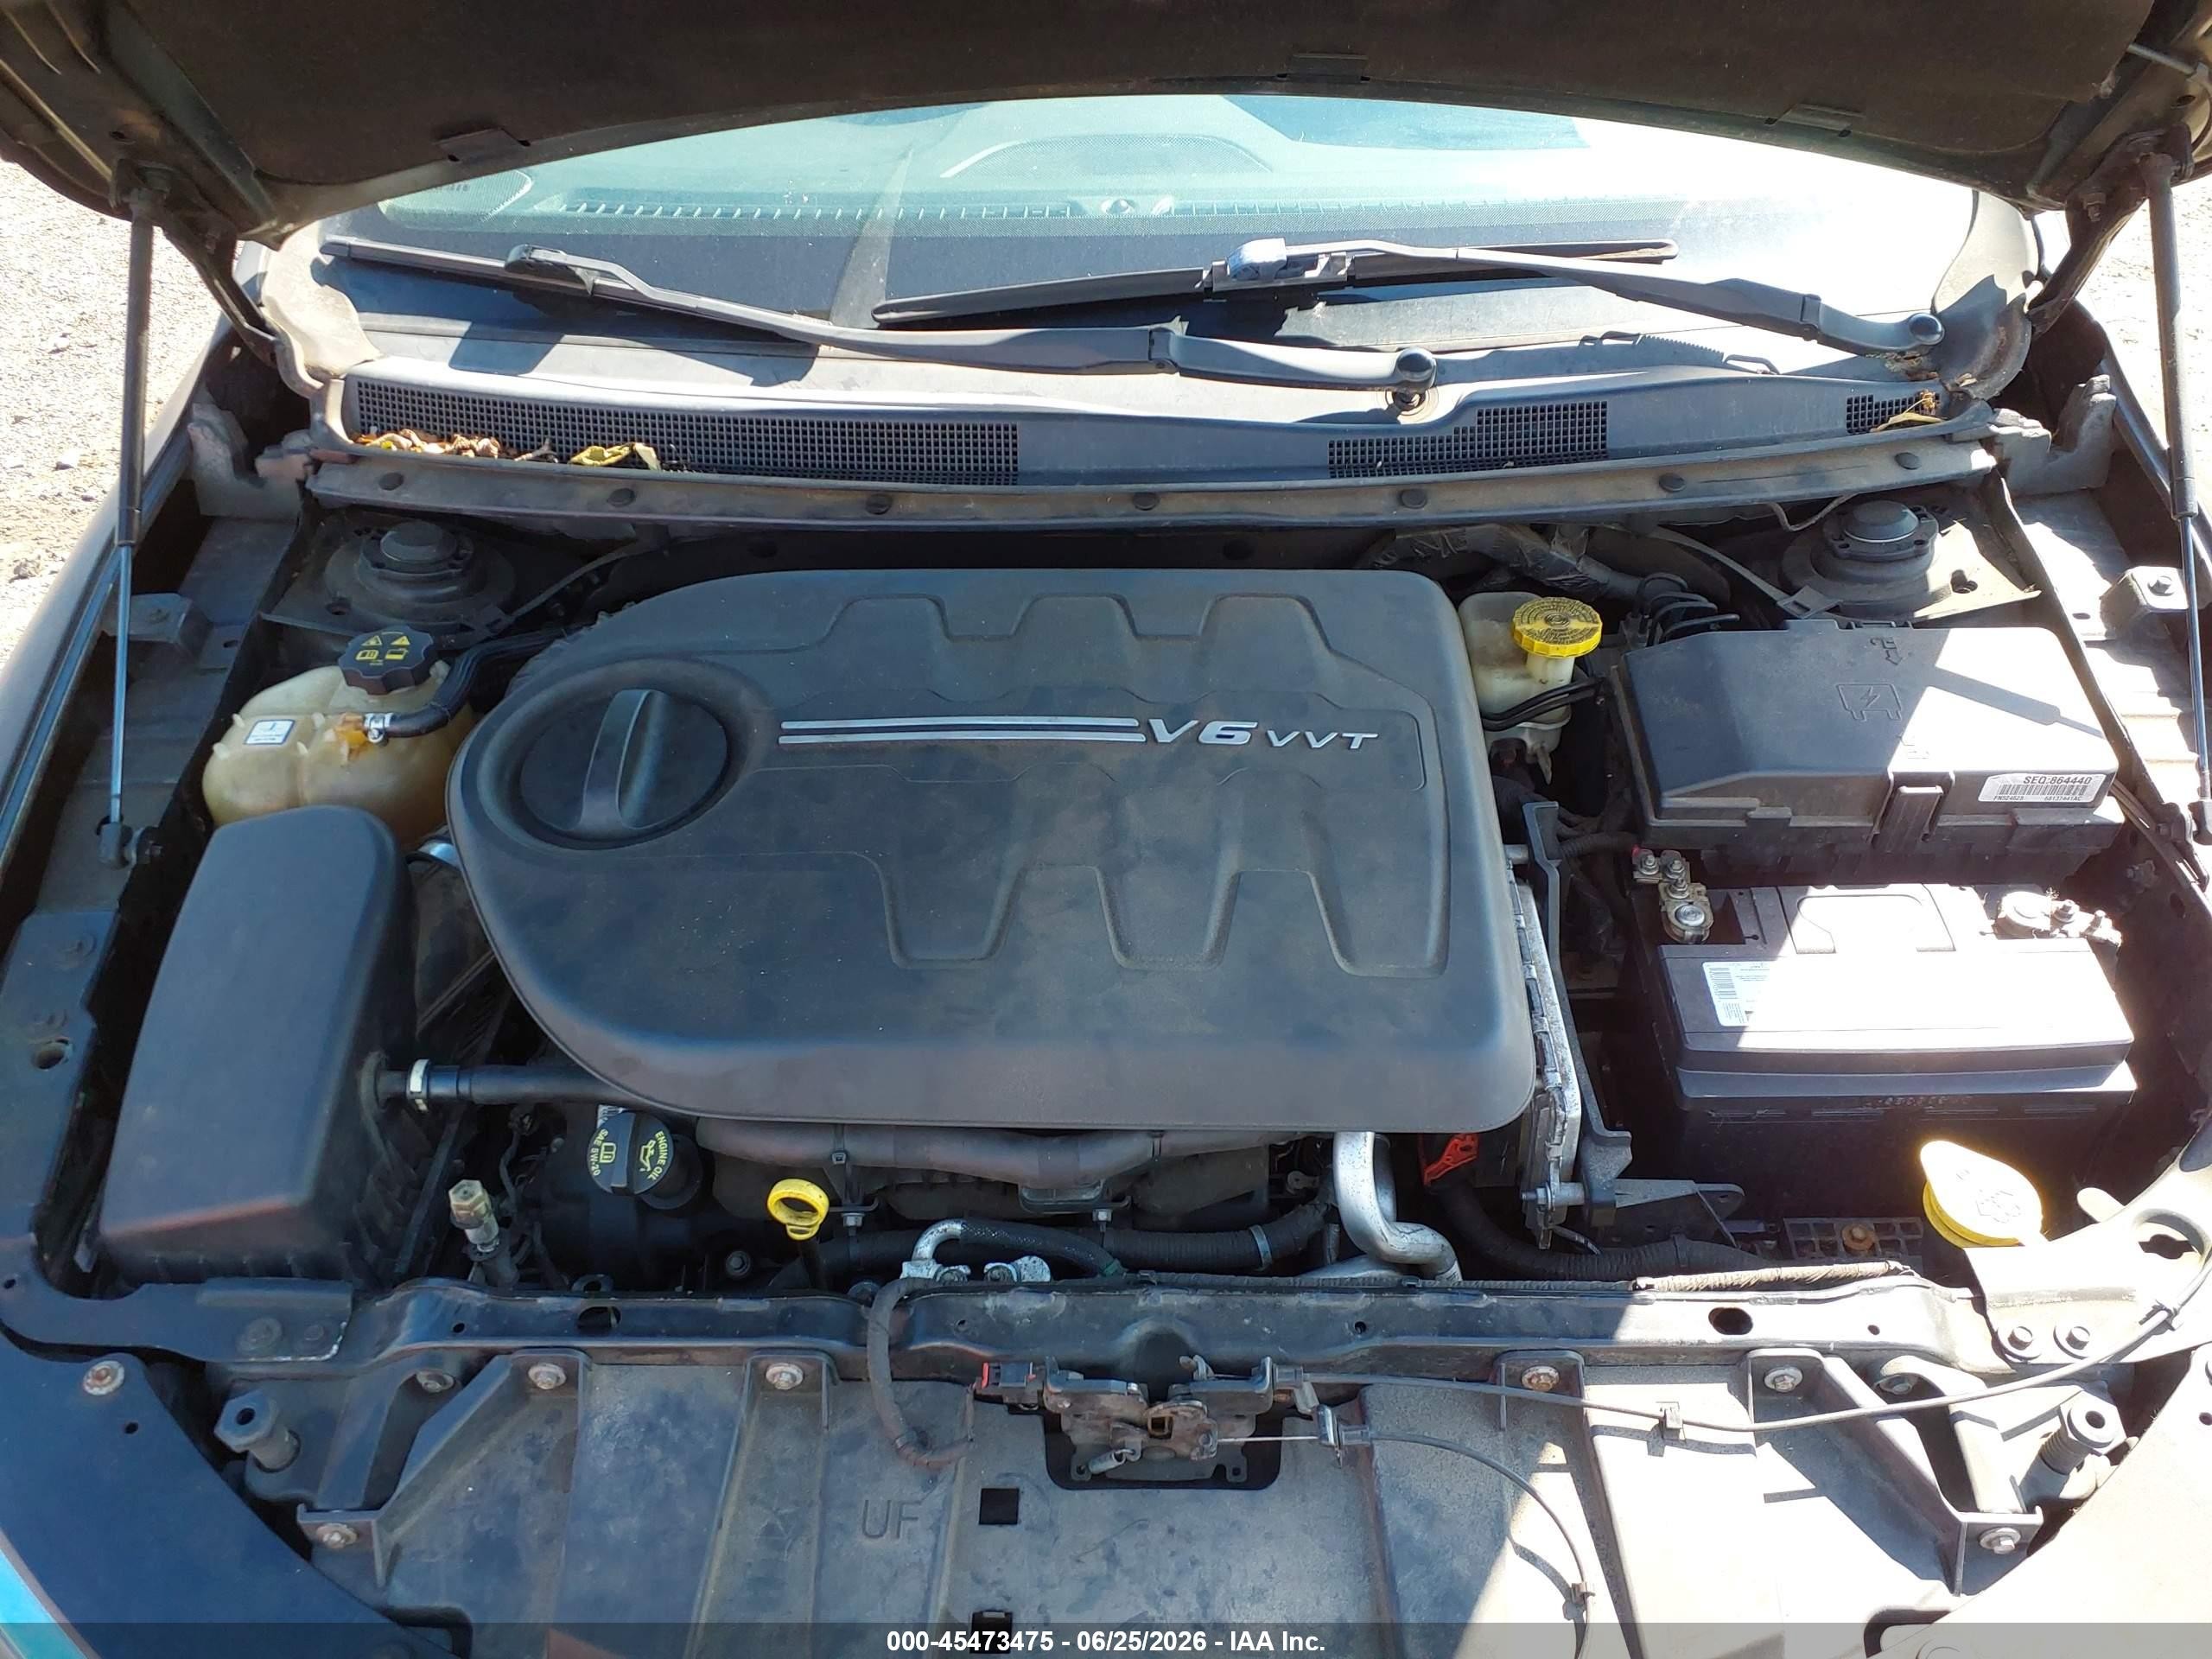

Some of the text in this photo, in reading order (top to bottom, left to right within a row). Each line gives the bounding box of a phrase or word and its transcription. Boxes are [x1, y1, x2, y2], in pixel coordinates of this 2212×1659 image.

[1148, 718, 1379, 750] V6 VVT
[593, 1128, 609, 1147] SAE
[647, 1130, 668, 1180] ENGINE OIL
[861, 1499, 923, 1539] UF
